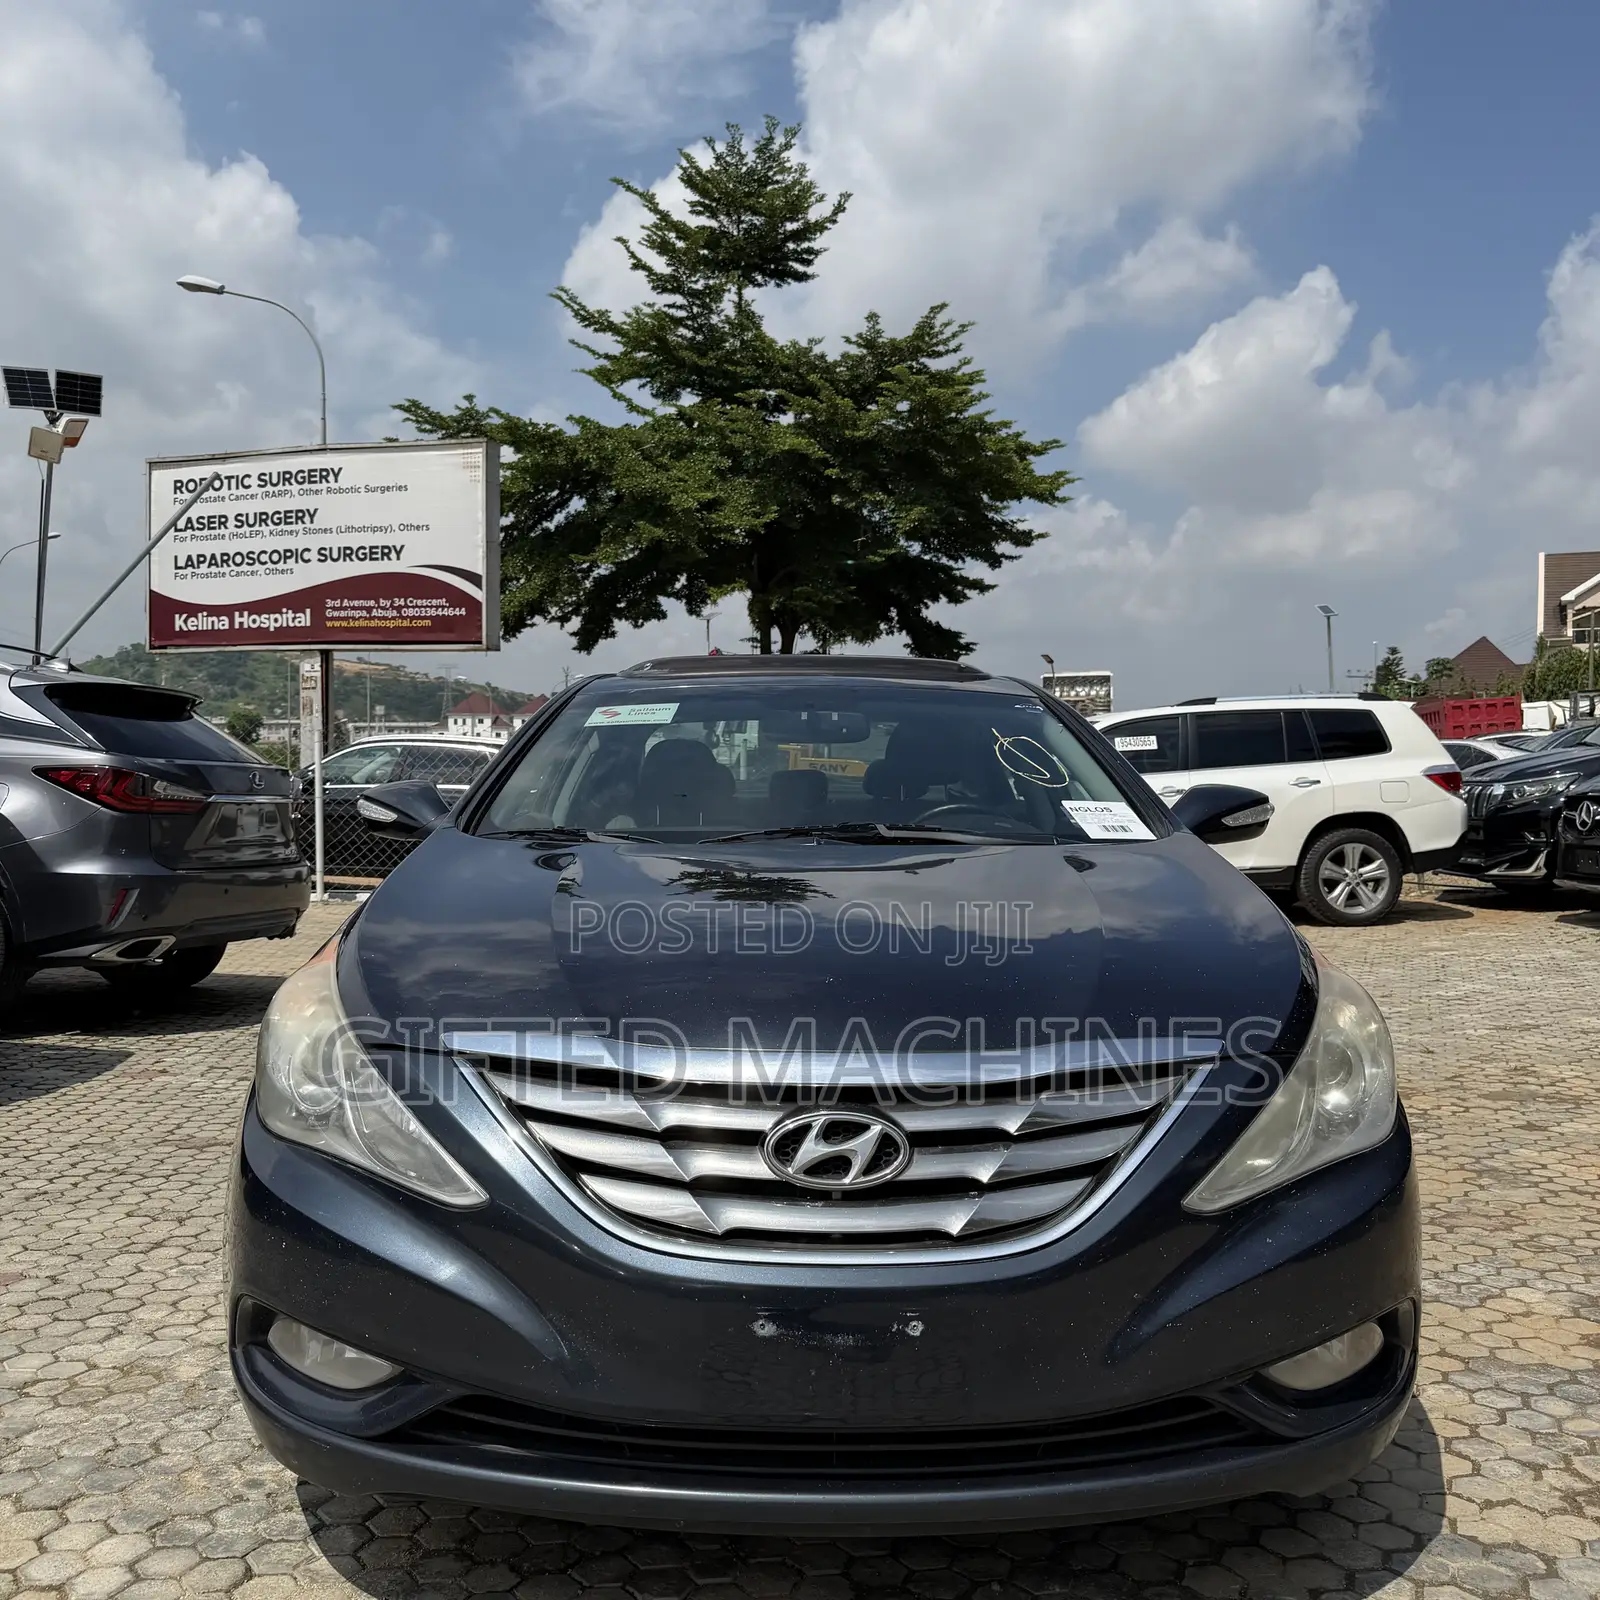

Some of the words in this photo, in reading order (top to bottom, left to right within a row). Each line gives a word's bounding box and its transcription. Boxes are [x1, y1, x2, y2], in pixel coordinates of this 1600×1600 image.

[257, 467, 343, 488] SURGERY
[228, 493, 259, 502] Cancer
[261, 490, 296, 501] (RARP),
[298, 488, 323, 497] Other
[326, 484, 361, 495] Robotic
[364, 483, 409, 494] Surgeries
[173, 514, 229, 533] LASER
[234, 508, 319, 529] SURGERY
[173, 535, 188, 543] For
[190, 533, 226, 542] Prostate
[228, 530, 267, 541] (HoLEP),
[269, 527, 300, 538] Kidney
[302, 526, 334, 536] Stones
[335, 524, 396, 535] (Lithotripsy),
[398, 522, 430, 532] Others
[174, 547, 312, 571] LAPAROSCOPIC
[316, 544, 405, 564] SURGERY
[174, 572, 189, 580] For
[190, 570, 227, 579] Prostate
[229, 568, 262, 578] Cancer,
[264, 567, 295, 576] Others
[325, 599, 341, 608] 3rd
[342, 598, 378, 608] Avenue,
[379, 598, 392, 608] by
[393, 598, 405, 607] 34
[406, 597, 450, 607] Crescent,
[174, 611, 230, 632] Kelina
[234, 608, 312, 632] Hospital
[325, 608, 370, 618] Gwarinpa,
[371, 608, 400, 618] Abuja.
[401, 607, 466, 617] 08033644644
[325, 618, 432, 628] www.kelinahospital.com
[808, 763, 851, 774] SANY
